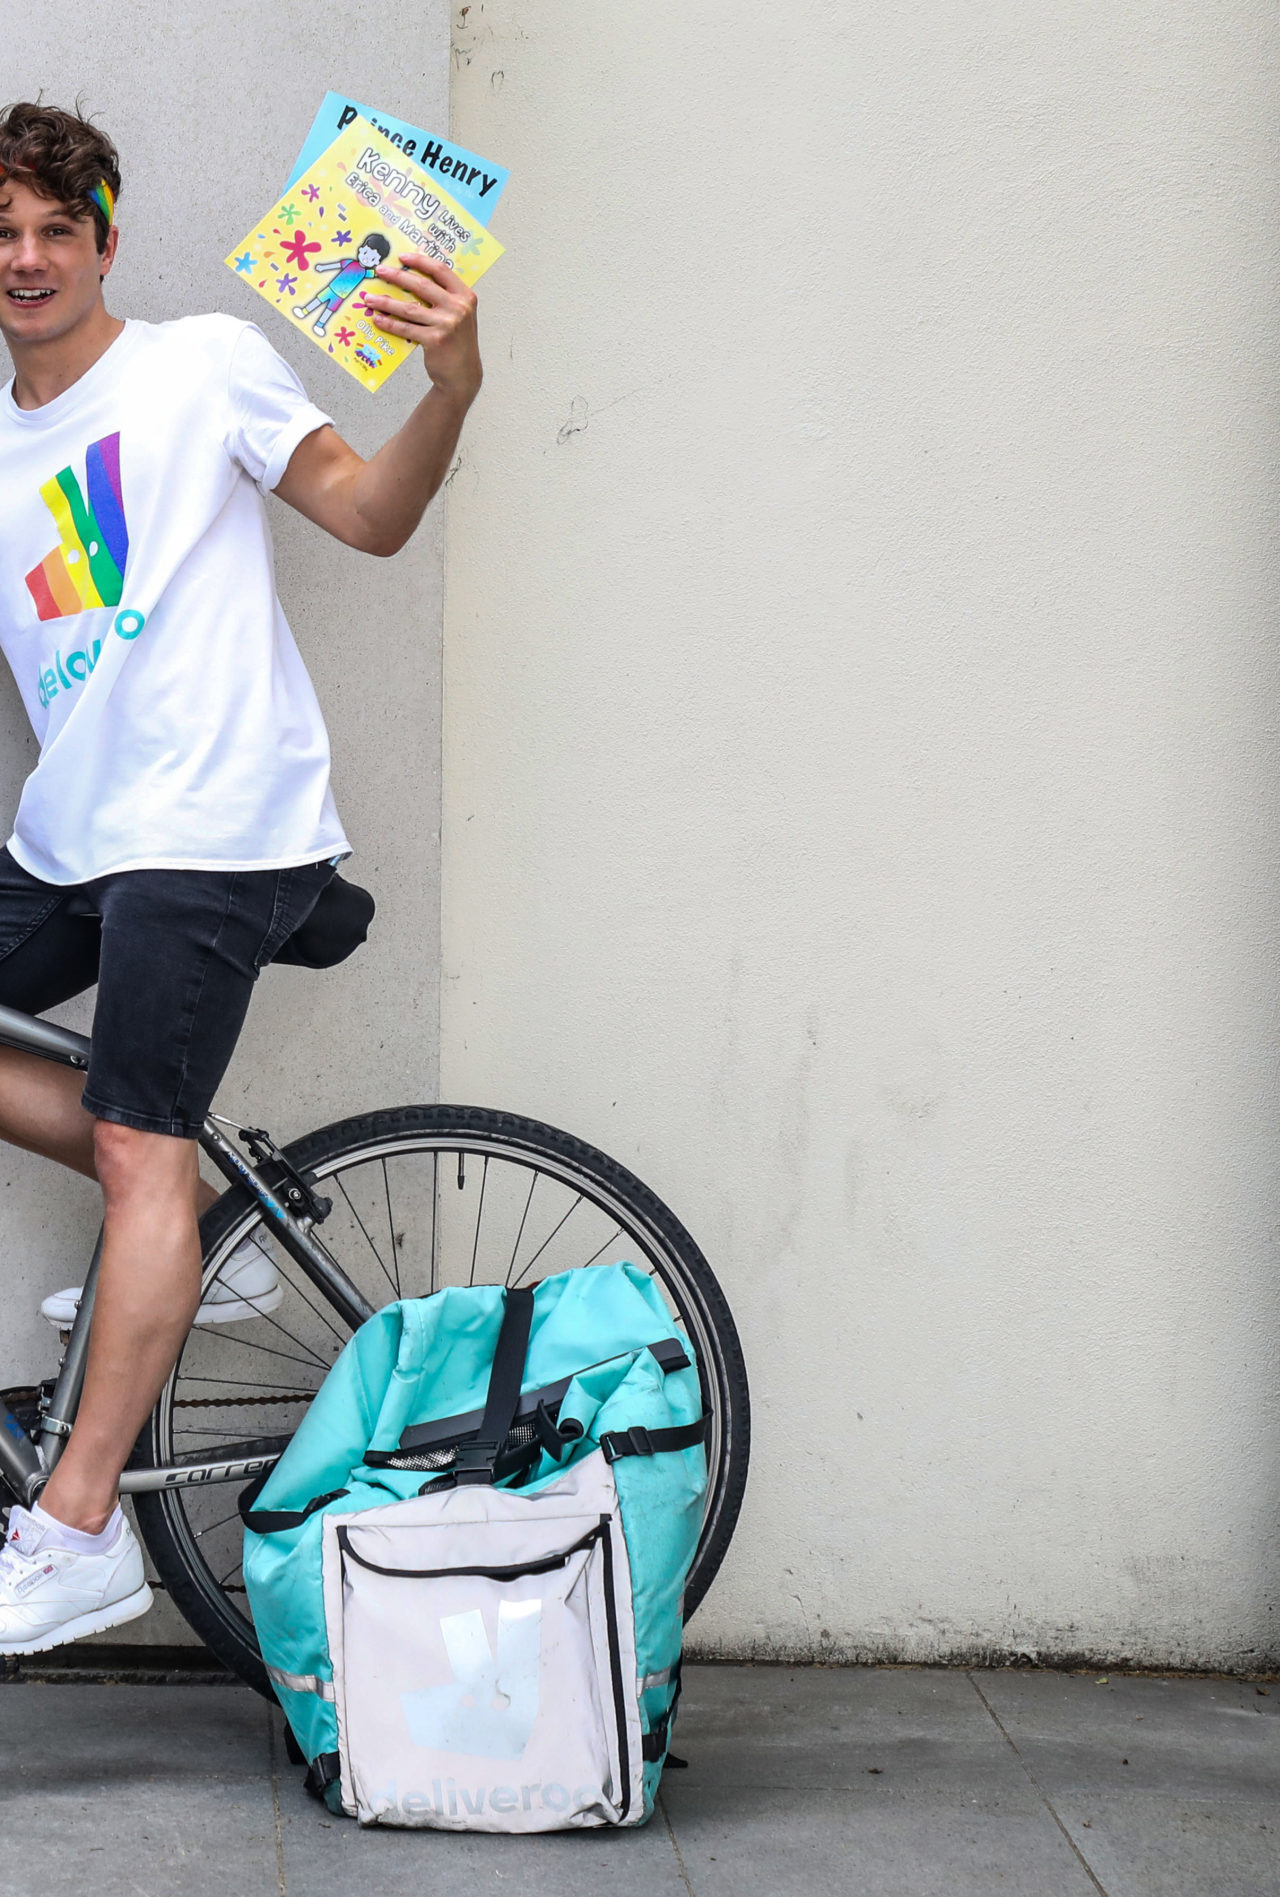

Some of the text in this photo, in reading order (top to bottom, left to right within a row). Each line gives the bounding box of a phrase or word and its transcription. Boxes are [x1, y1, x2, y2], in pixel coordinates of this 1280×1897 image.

[336, 104, 498, 198] Pince Henry
[345, 172, 381, 207] Erica
[379, 201, 400, 224] and
[357, 147, 471, 242] Kenny Lives
[428, 223, 457, 253] with
[356, 319, 375, 341] Olly
[374, 336, 395, 356] Pike
[164, 1459, 277, 1486] carrer
